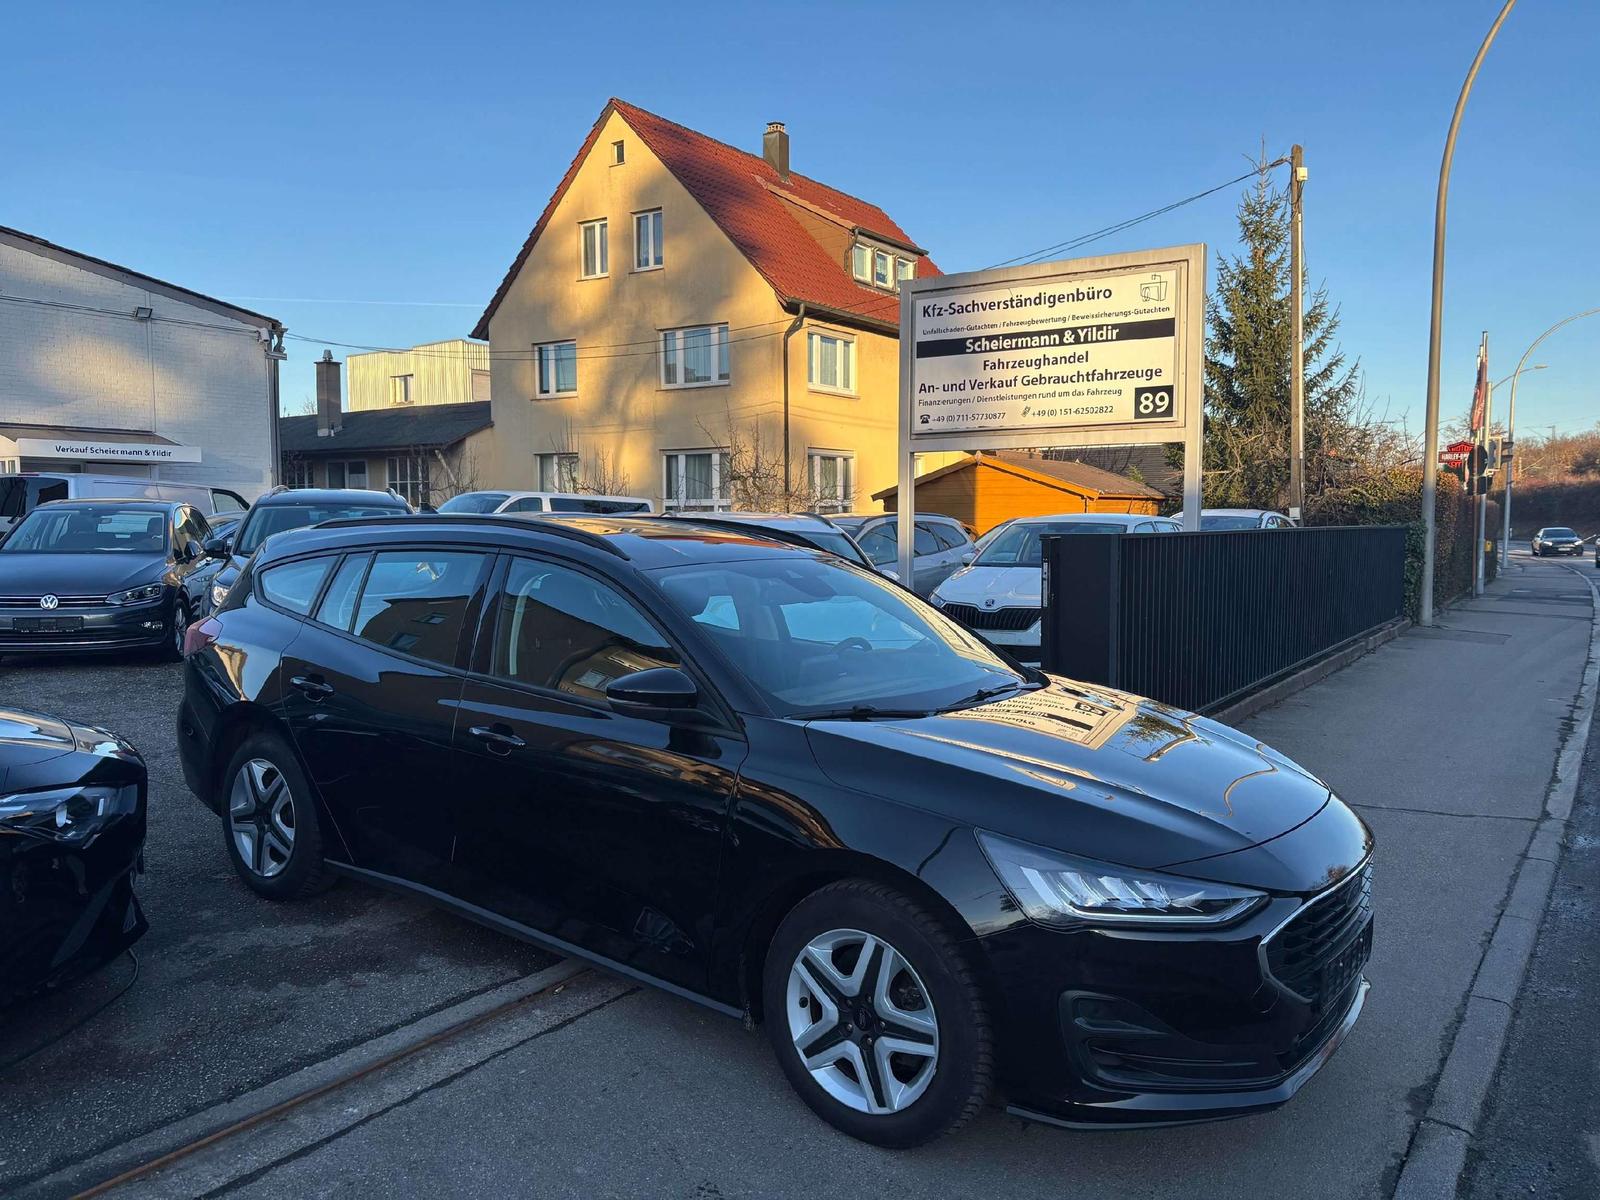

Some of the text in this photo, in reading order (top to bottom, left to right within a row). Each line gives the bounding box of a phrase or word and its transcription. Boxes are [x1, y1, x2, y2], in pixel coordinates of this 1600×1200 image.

[922, 286, 1113, 318] Kfz-Sachverständigenbüro
[922, 322, 999, 335] Unfallschaden-Gutachten
[1002, 315, 1067, 327] Fahrzeugbewertung
[1071, 306, 1170, 321] Beweissicherungs-Gutachten
[965, 325, 1119, 353] Scheiermann & Yildir
[983, 351, 1089, 371] Fahrzeughandel
[918, 366, 1163, 394] An- und Verkauf Gebrauchtfahrzeuge
[918, 396, 971, 407] Finanzierungen
[976, 391, 1037, 404] Dienstleistungen
[1038, 389, 1057, 399] rund
[1058, 390, 1071, 398] um
[1072, 387, 1085, 397] das
[1086, 387, 1122, 398] Fahrzeug
[1138, 391, 1170, 414] 89
[932, 414, 945, 423] +49
[946, 413, 955, 423] (0)
[1032, 408, 1046, 418] +49
[1047, 407, 1058, 418] (0)
[55, 445, 88, 454] Verkauf
[90, 446, 143, 456] Scheiermann
[151, 449, 172, 457] Yildir
[40, 594, 59, 610] VW
